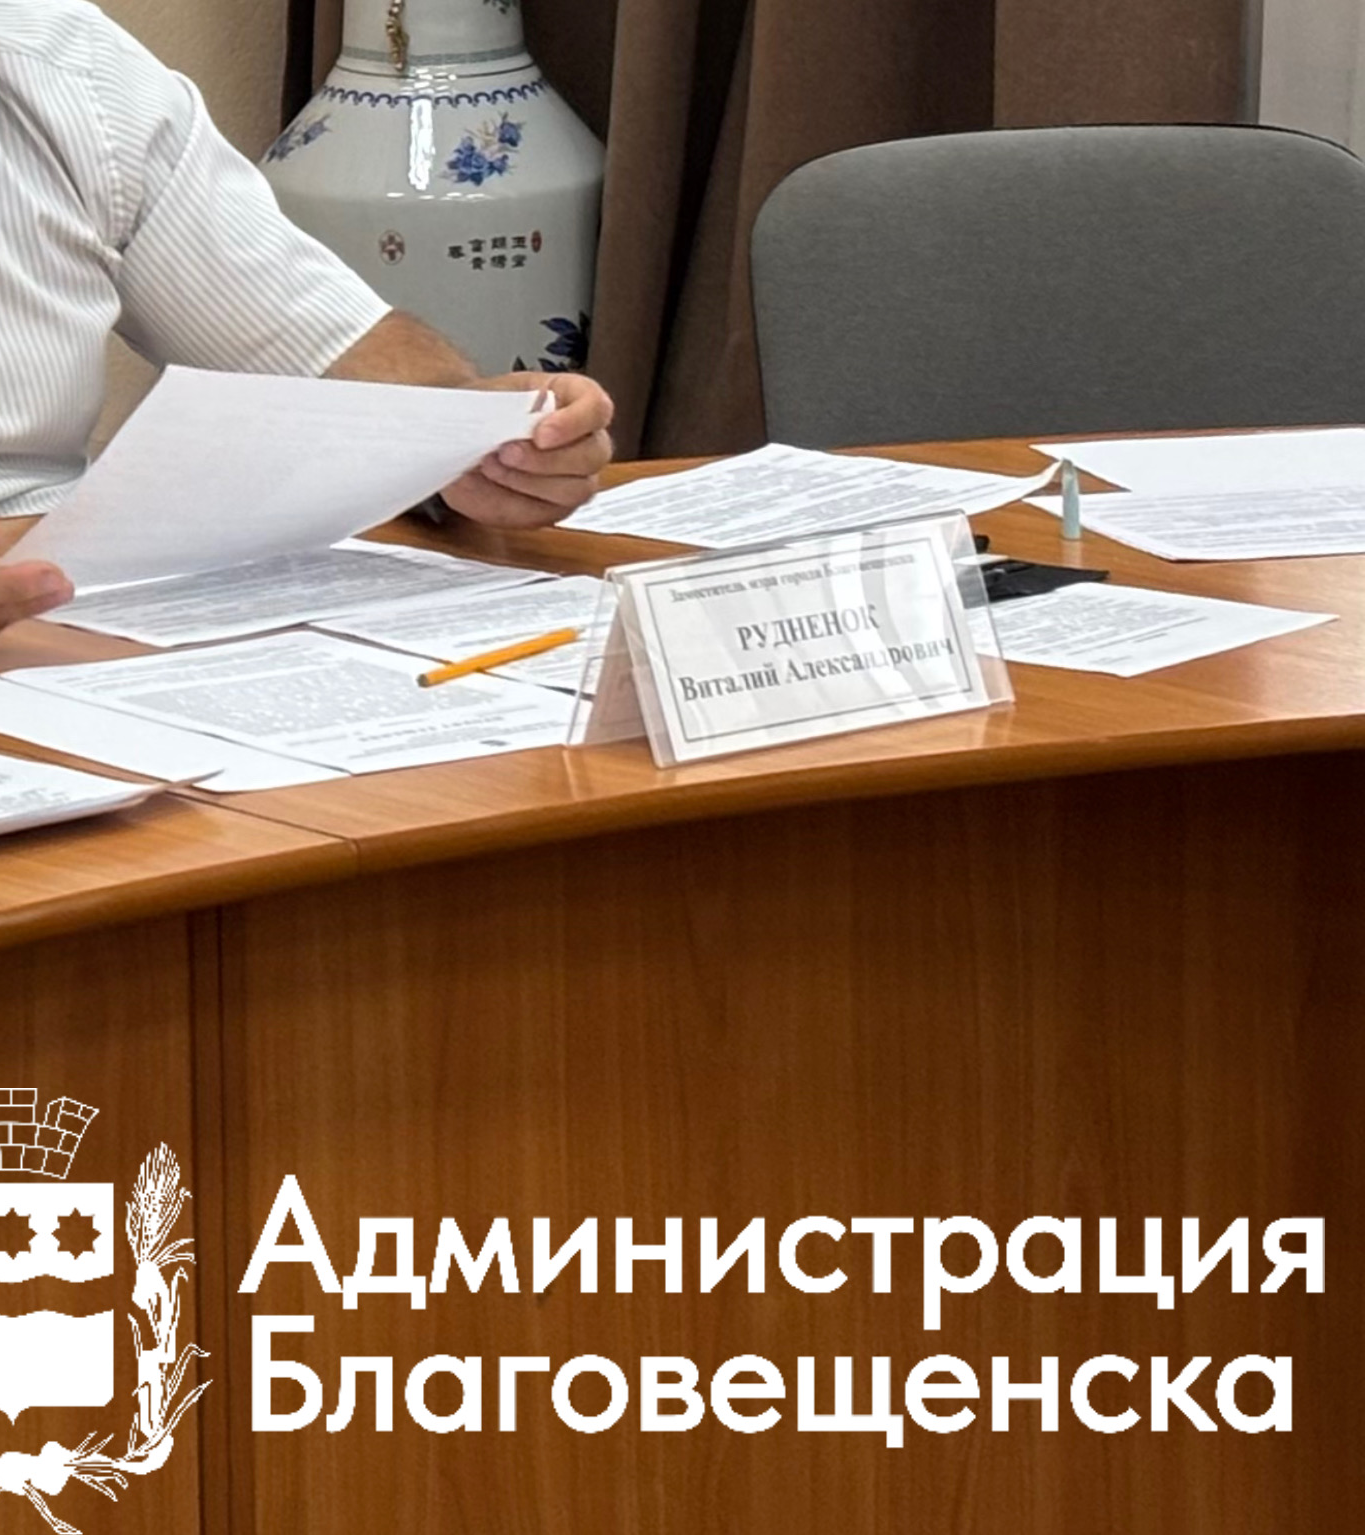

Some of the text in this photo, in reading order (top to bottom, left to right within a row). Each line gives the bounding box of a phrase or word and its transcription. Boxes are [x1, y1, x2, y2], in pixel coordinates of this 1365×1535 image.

[736, 604, 880, 651] РУДНЕНОК
[678, 637, 955, 702] Виталий Александрович
